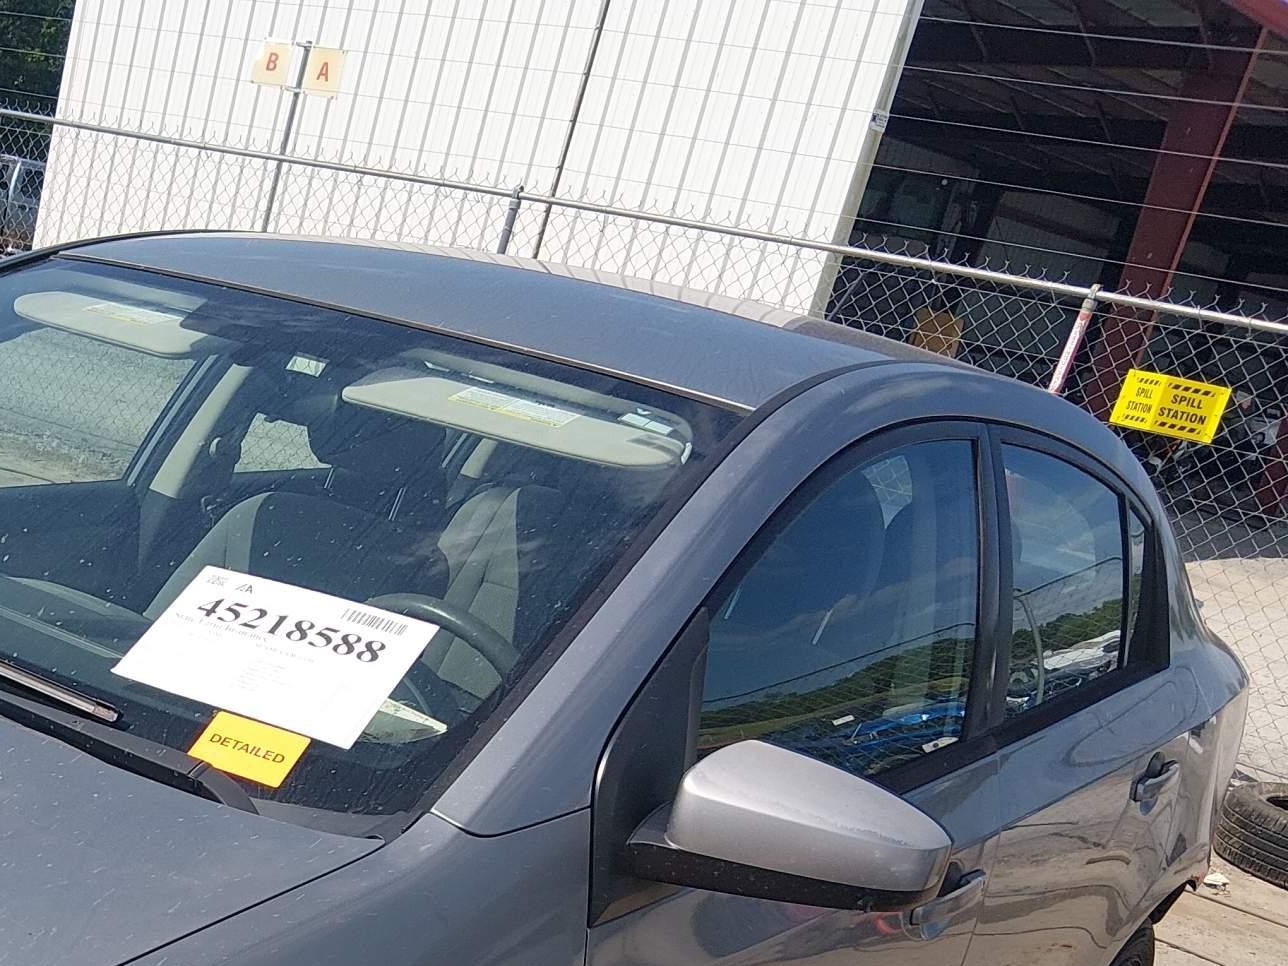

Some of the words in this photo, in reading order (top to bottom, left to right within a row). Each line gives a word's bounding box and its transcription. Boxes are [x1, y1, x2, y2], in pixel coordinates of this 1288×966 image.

[265, 52, 279, 71] B
[316, 61, 329, 82] A
[1135, 386, 1154, 400] SPILL
[1170, 393, 1203, 410] SPILL
[1125, 400, 1152, 414] STATION
[1158, 406, 1207, 425] STATION
[197, 598, 386, 663] 45218588
[209, 733, 286, 764] DETAILED
